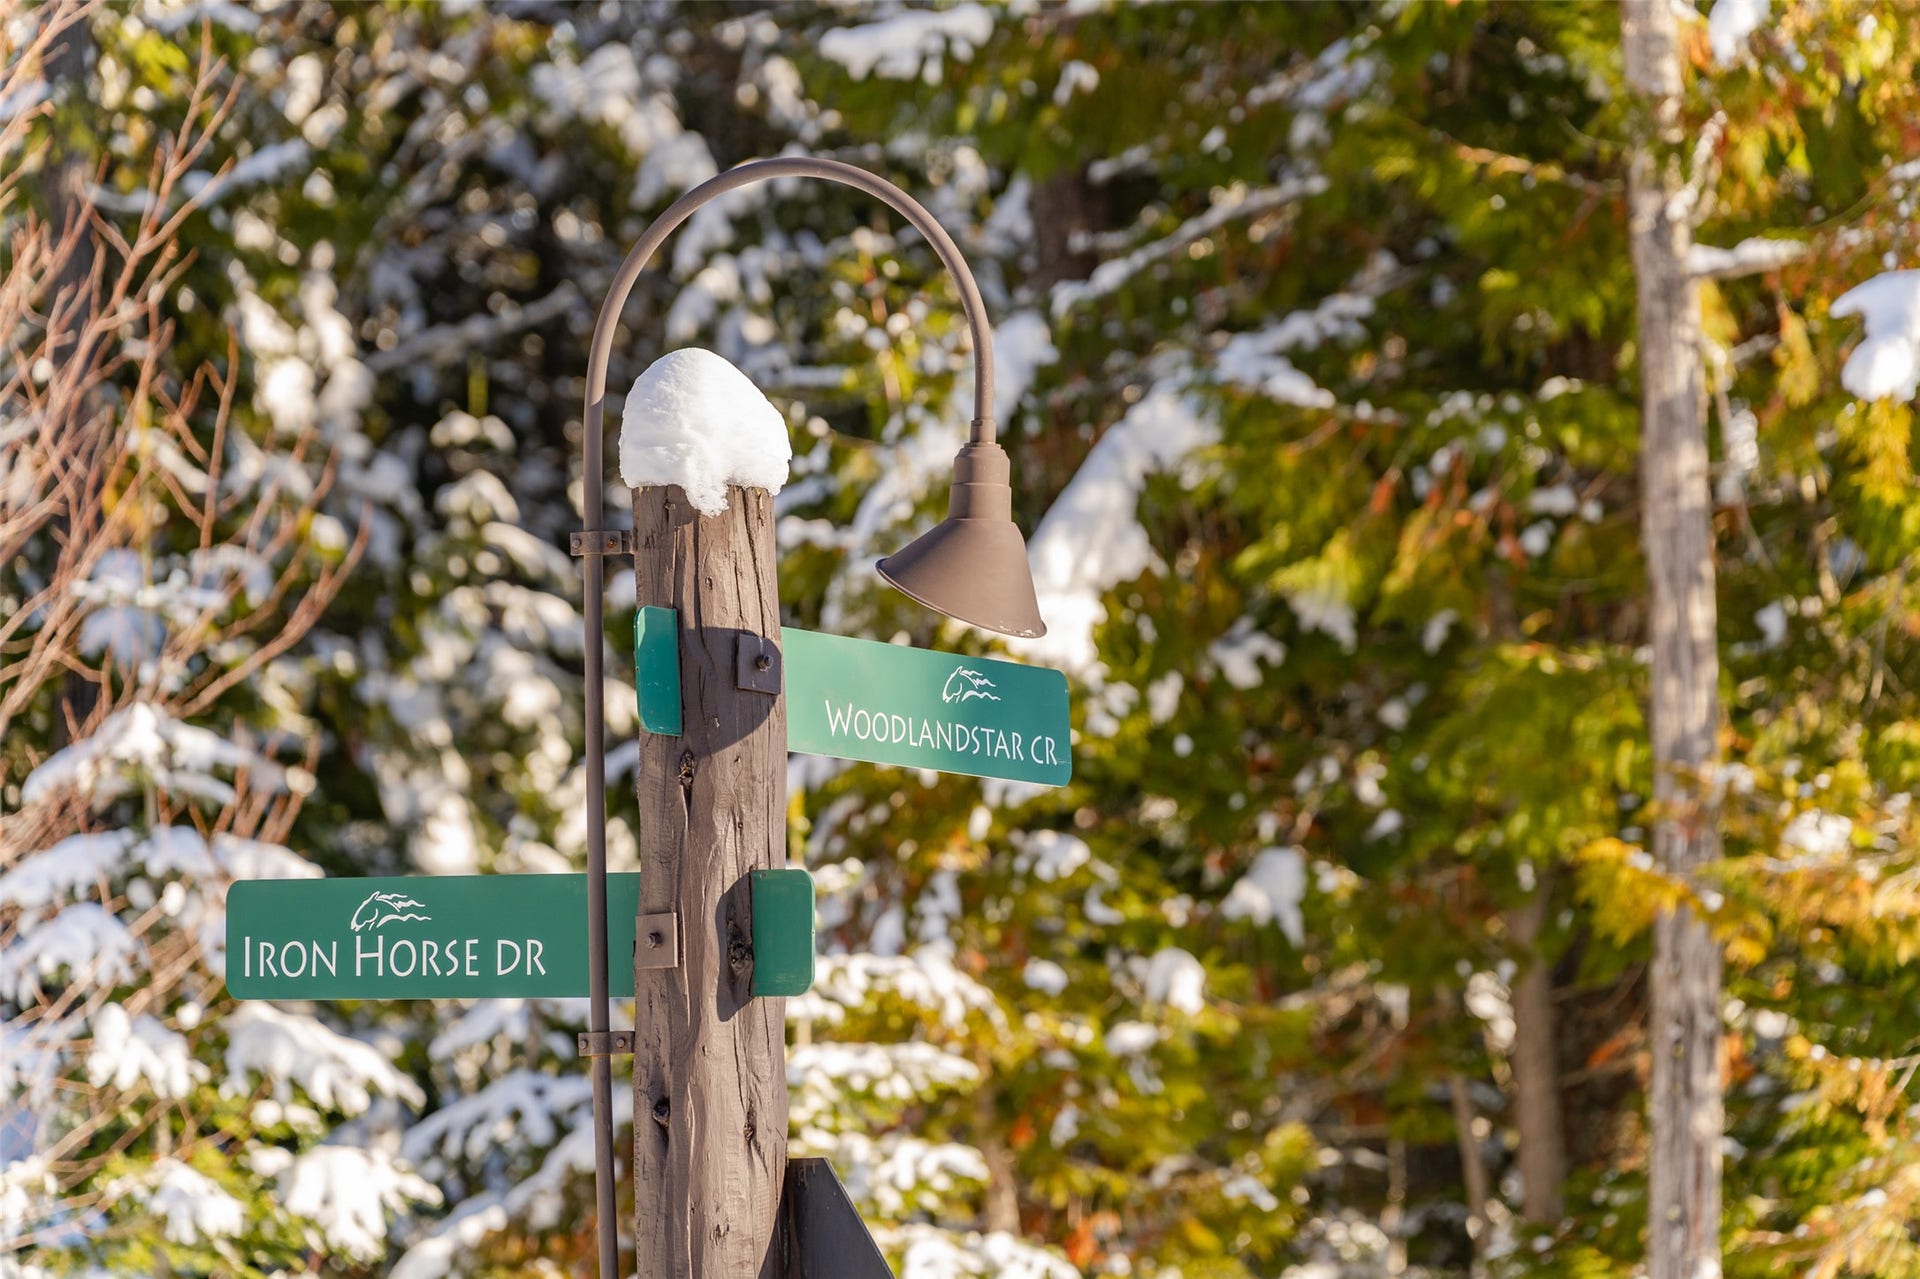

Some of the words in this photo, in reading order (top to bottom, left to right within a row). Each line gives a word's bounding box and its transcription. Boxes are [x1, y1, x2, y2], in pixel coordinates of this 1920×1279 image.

[825, 699, 1024, 762] WOODLANDSTAR
[1031, 735, 1058, 766] CR
[244, 936, 337, 978] IRON
[355, 935, 480, 977] HORSE
[496, 938, 547, 976] DR
